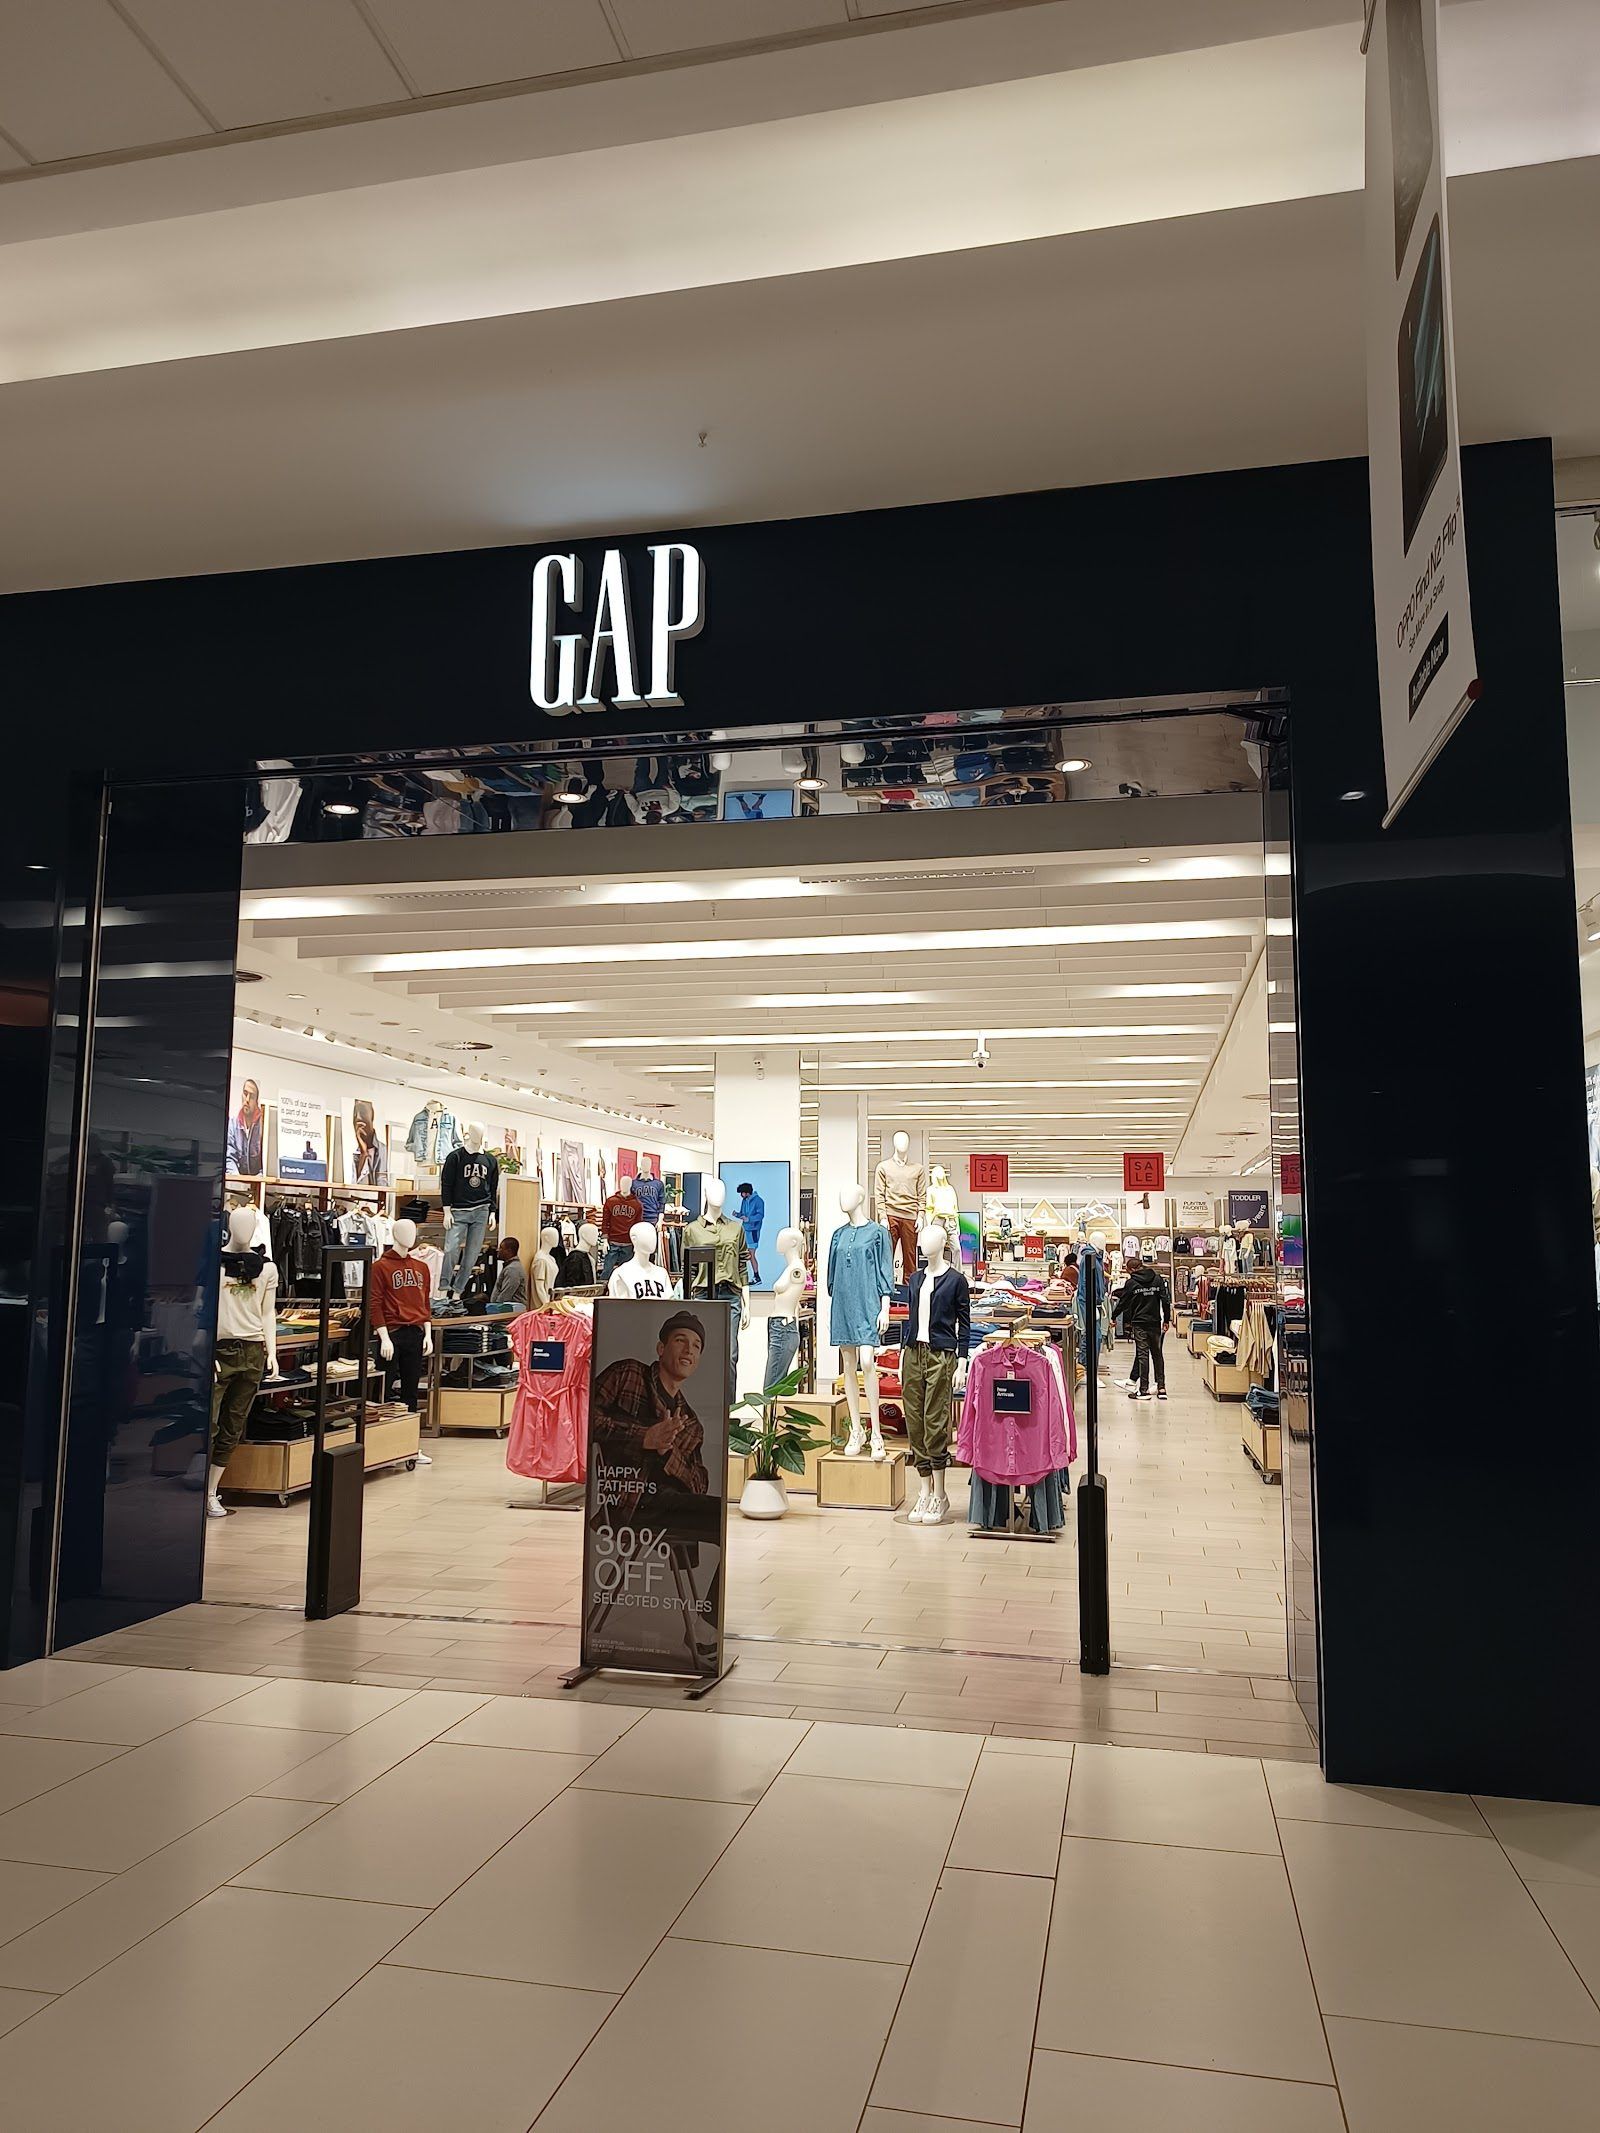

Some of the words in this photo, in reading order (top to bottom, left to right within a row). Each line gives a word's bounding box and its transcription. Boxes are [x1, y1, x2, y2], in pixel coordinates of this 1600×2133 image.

[1397, 593, 1415, 649] OPPO
[1415, 558, 1430, 611] Find
[1431, 536, 1441, 579] N2
[1443, 512, 1457, 556] Flip
[530, 543, 704, 714] GAP
[463, 1163, 488, 1180] GAP
[980, 1163, 998, 1172] SA
[1134, 1161, 1153, 1171] SA
[981, 1173, 998, 1183] LE
[1135, 1172, 1153, 1182] LE
[635, 1185, 658, 1198] GAP
[612, 1204, 636, 1219] GAP
[1253, 1204, 1267, 1223] years
[634, 1279, 665, 1299] GAP
[597, 1465, 642, 1479] HAPPY
[597, 1479, 657, 1495] FATHER'S
[596, 1493, 621, 1506] DAY
[595, 1524, 671, 1560] 30%
[594, 1558, 665, 1593] OFF
[593, 1591, 659, 1608] SELECTED
[662, 1597, 712, 1612] STYLES
